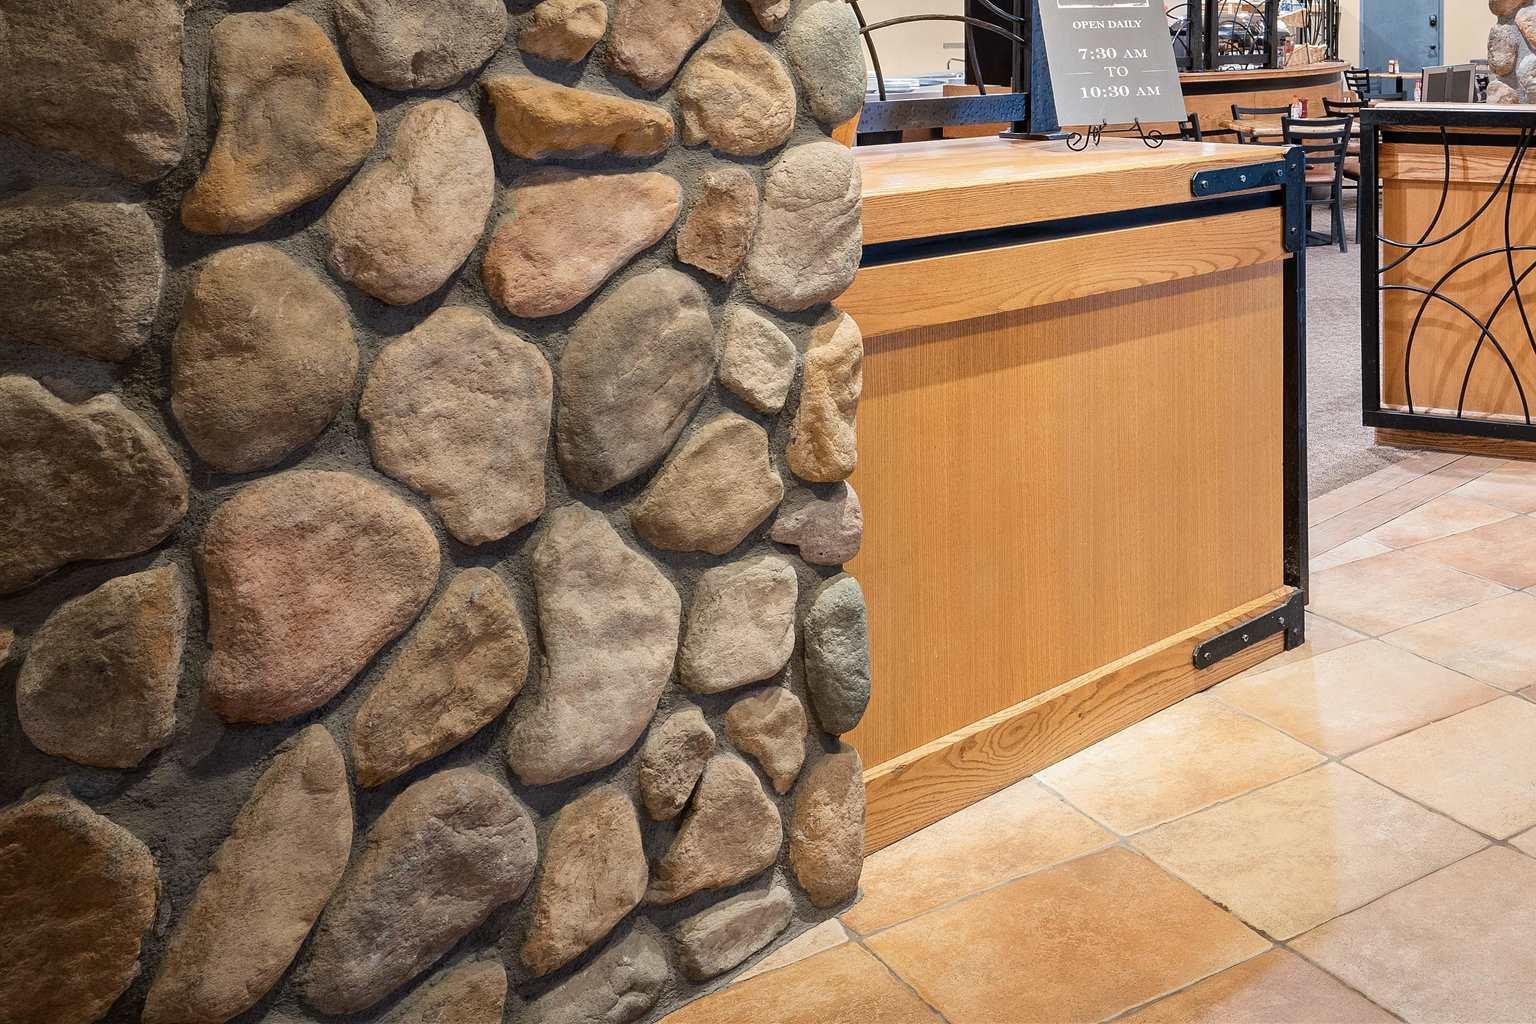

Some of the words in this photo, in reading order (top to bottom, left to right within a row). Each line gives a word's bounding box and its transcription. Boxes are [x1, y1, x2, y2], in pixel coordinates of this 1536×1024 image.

[1072, 20, 1106, 30] OPEN
[1108, 19, 1143, 29] DAILY
[1078, 47, 1117, 61] 7:30
[1123, 48, 1149, 60] AM
[1103, 66, 1129, 77] TO
[1080, 85, 1130, 99] 10:30
[1136, 86, 1161, 97] AM
